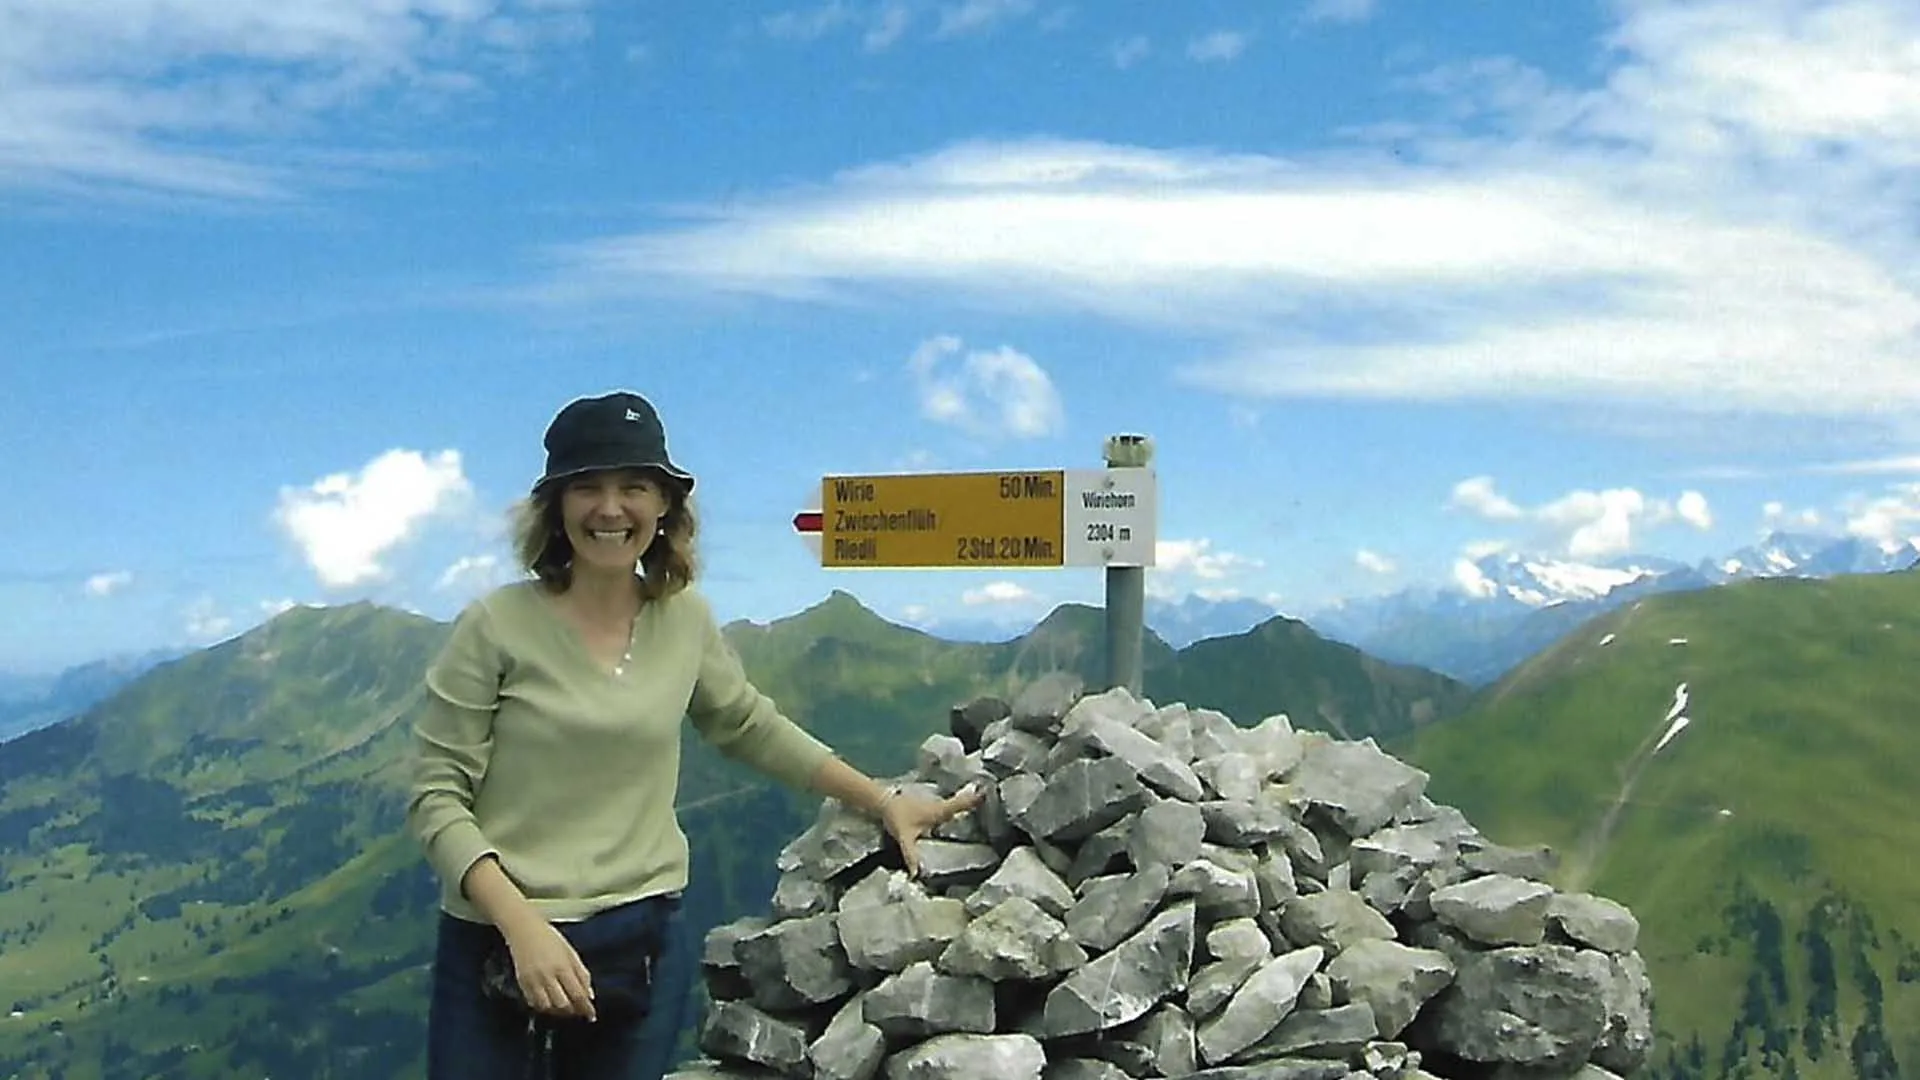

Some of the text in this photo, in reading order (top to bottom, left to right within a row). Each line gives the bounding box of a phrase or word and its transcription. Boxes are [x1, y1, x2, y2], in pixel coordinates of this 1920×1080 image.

[835, 480, 875, 502] Wirie
[1000, 476, 1056, 500] 50 Min.
[1082, 491, 1136, 508] Wiriehorn
[1087, 523, 1131, 541] 2304 m
[1000, 536, 1021, 560] 20
